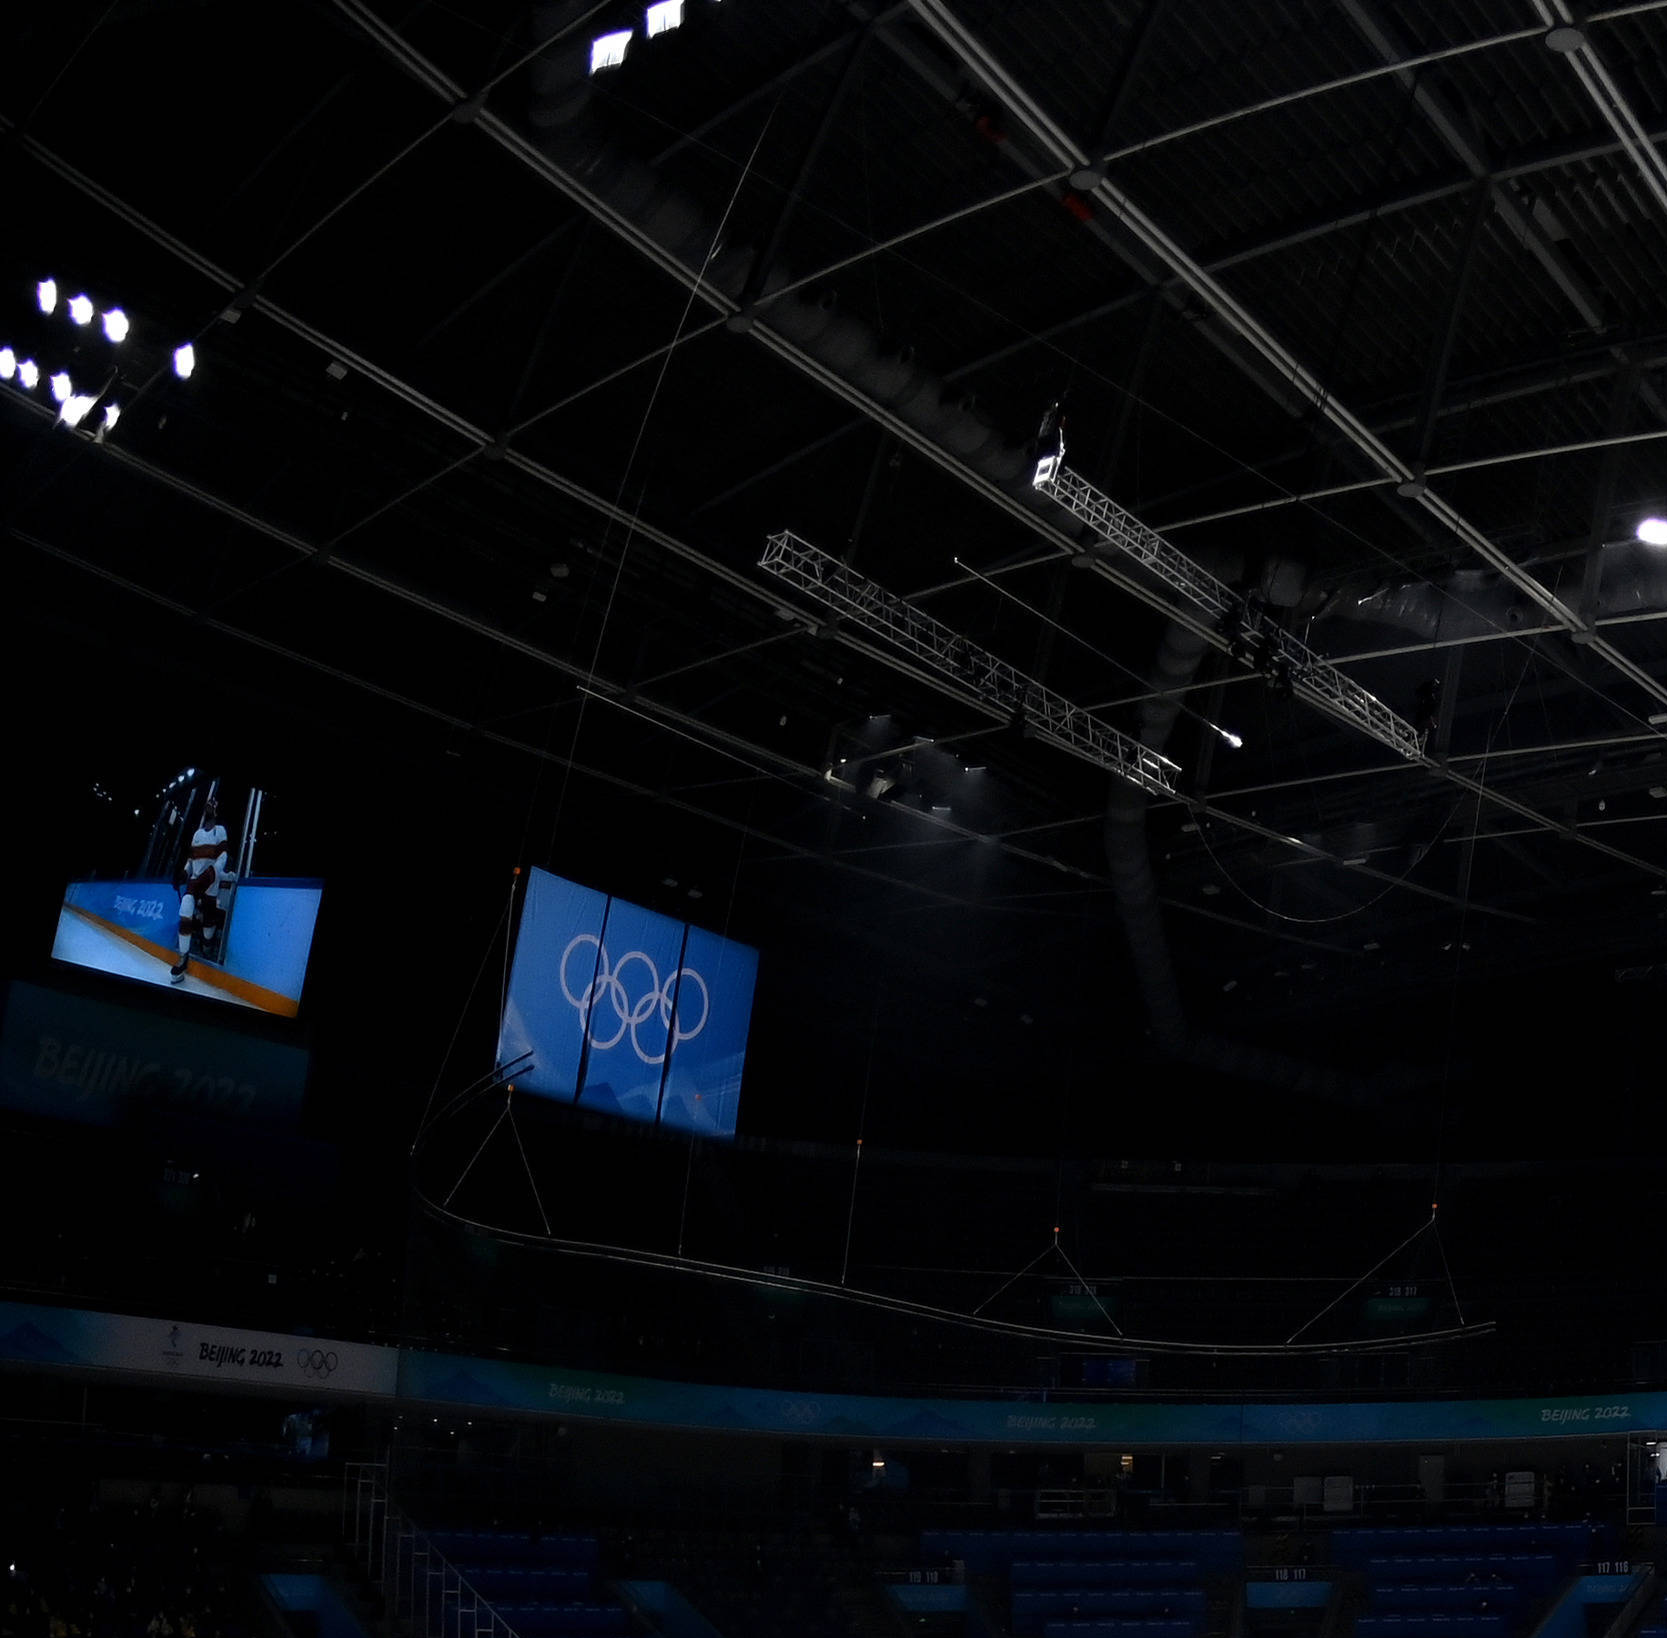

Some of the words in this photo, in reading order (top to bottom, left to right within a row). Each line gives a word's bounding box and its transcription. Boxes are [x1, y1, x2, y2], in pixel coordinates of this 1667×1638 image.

[199, 1342, 247, 1368] BEIJING
[249, 1349, 284, 1368] 2022
[1540, 1407, 1591, 1425] BEIJING
[1593, 1405, 1632, 1420] 2022
